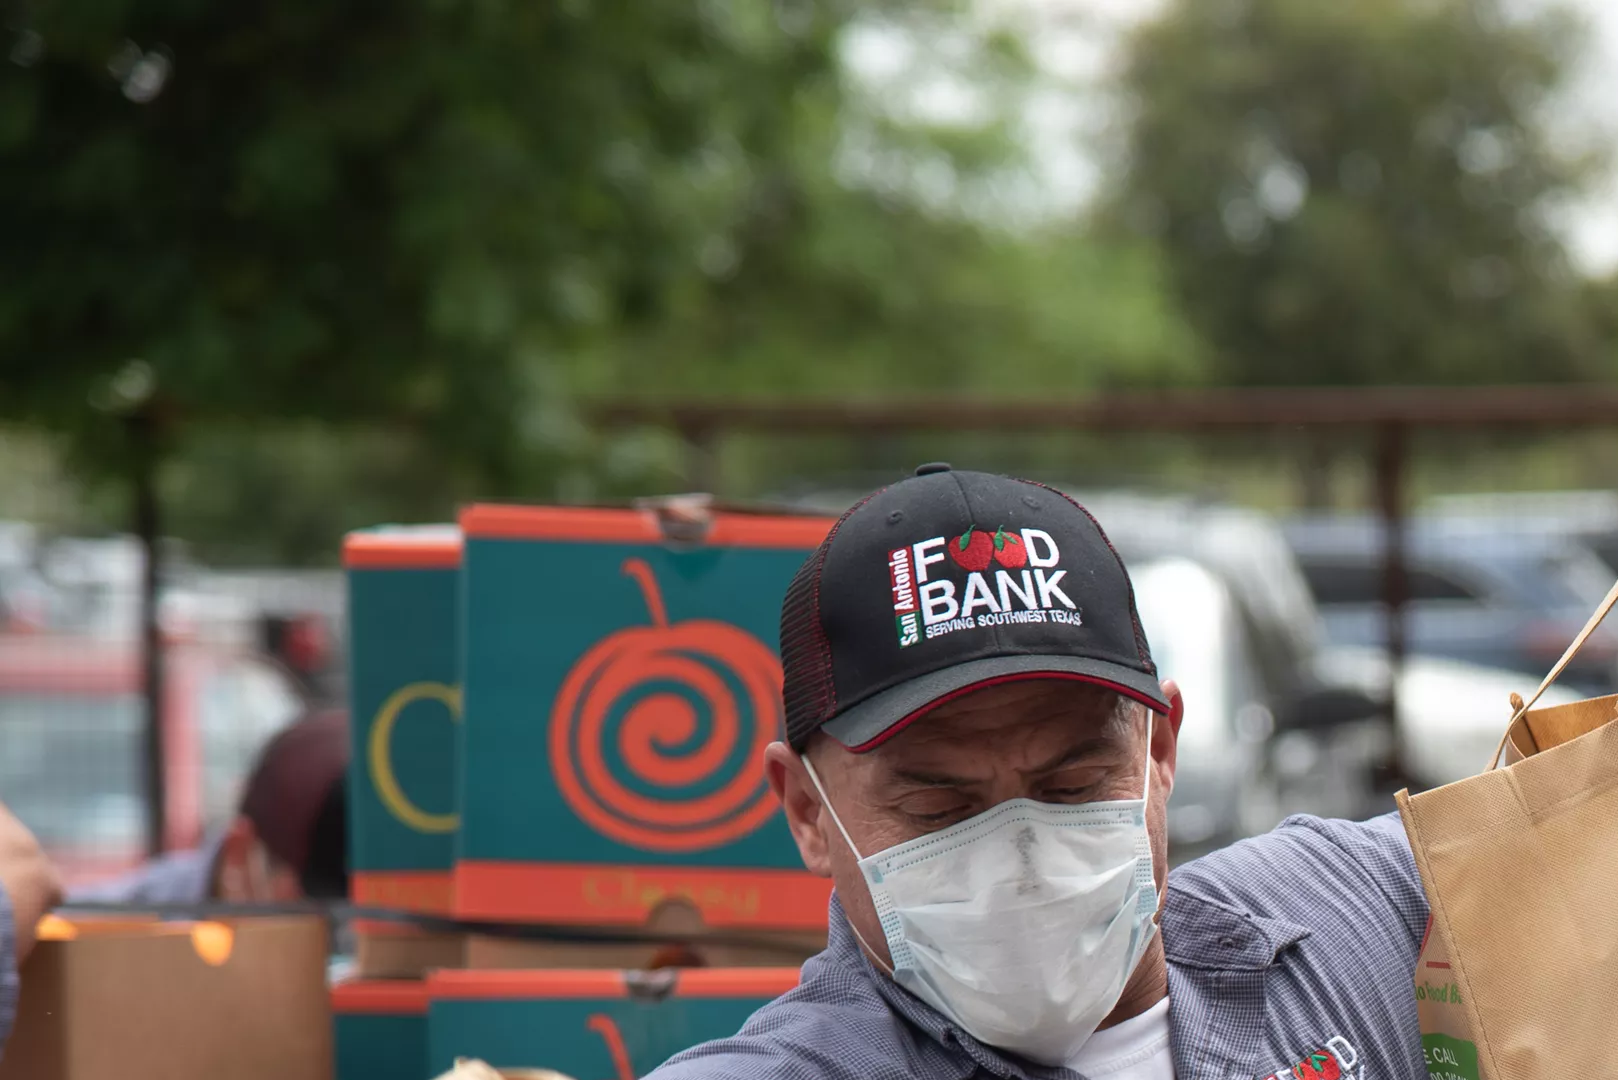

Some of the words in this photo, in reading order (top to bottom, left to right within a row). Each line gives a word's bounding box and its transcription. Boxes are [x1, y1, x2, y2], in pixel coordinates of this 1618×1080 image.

[889, 548, 915, 611] Antonio
[919, 568, 1077, 626] BANK
[900, 613, 920, 647] San
[925, 614, 976, 640] SERVING
[977, 609, 1049, 628] SOUTHWEST
[1049, 609, 1083, 627] TEXAS
